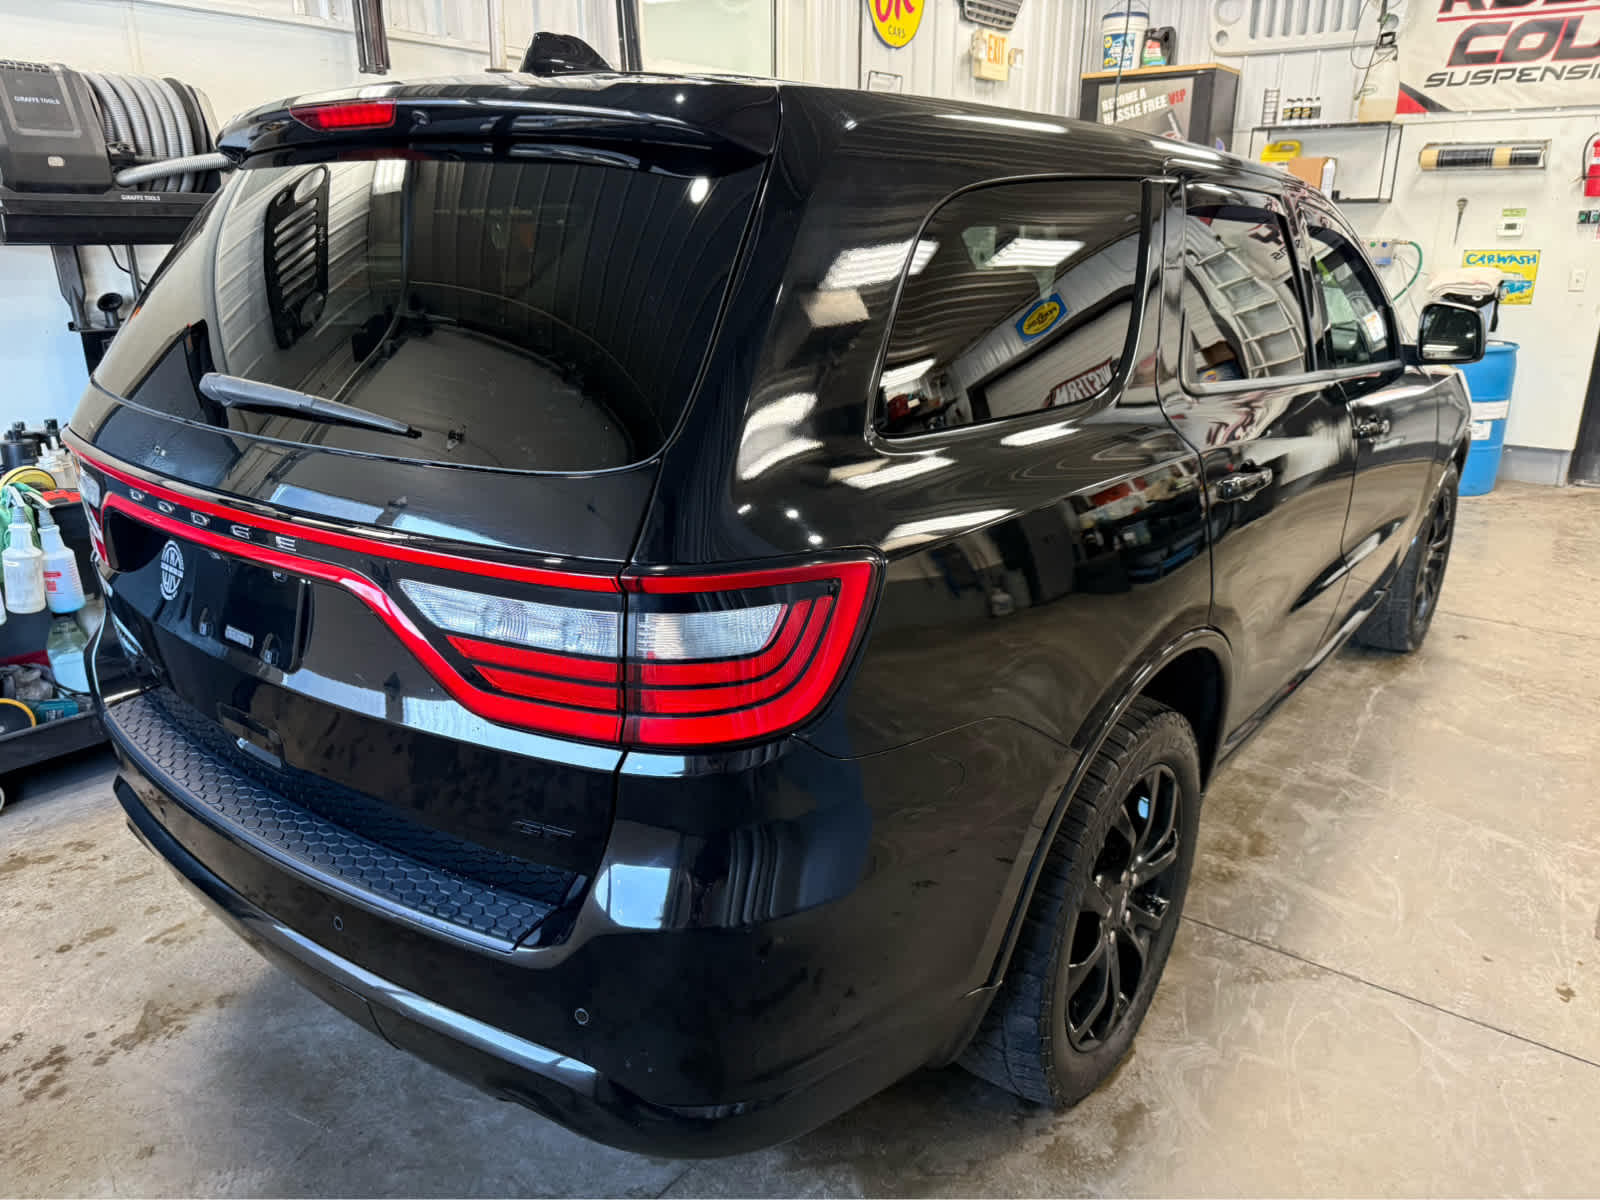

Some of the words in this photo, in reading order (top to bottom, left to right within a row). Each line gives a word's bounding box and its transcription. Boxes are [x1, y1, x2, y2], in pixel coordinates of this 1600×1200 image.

[987, 33, 1007, 65] EXIT
[1424, 64, 1600, 88] SUSPENSI
[1101, 89, 1139, 112] BEOME
[1142, 94, 1168, 114] FREE
[1168, 88, 1187, 106] VIP
[128, 488, 298, 553] DODGE
